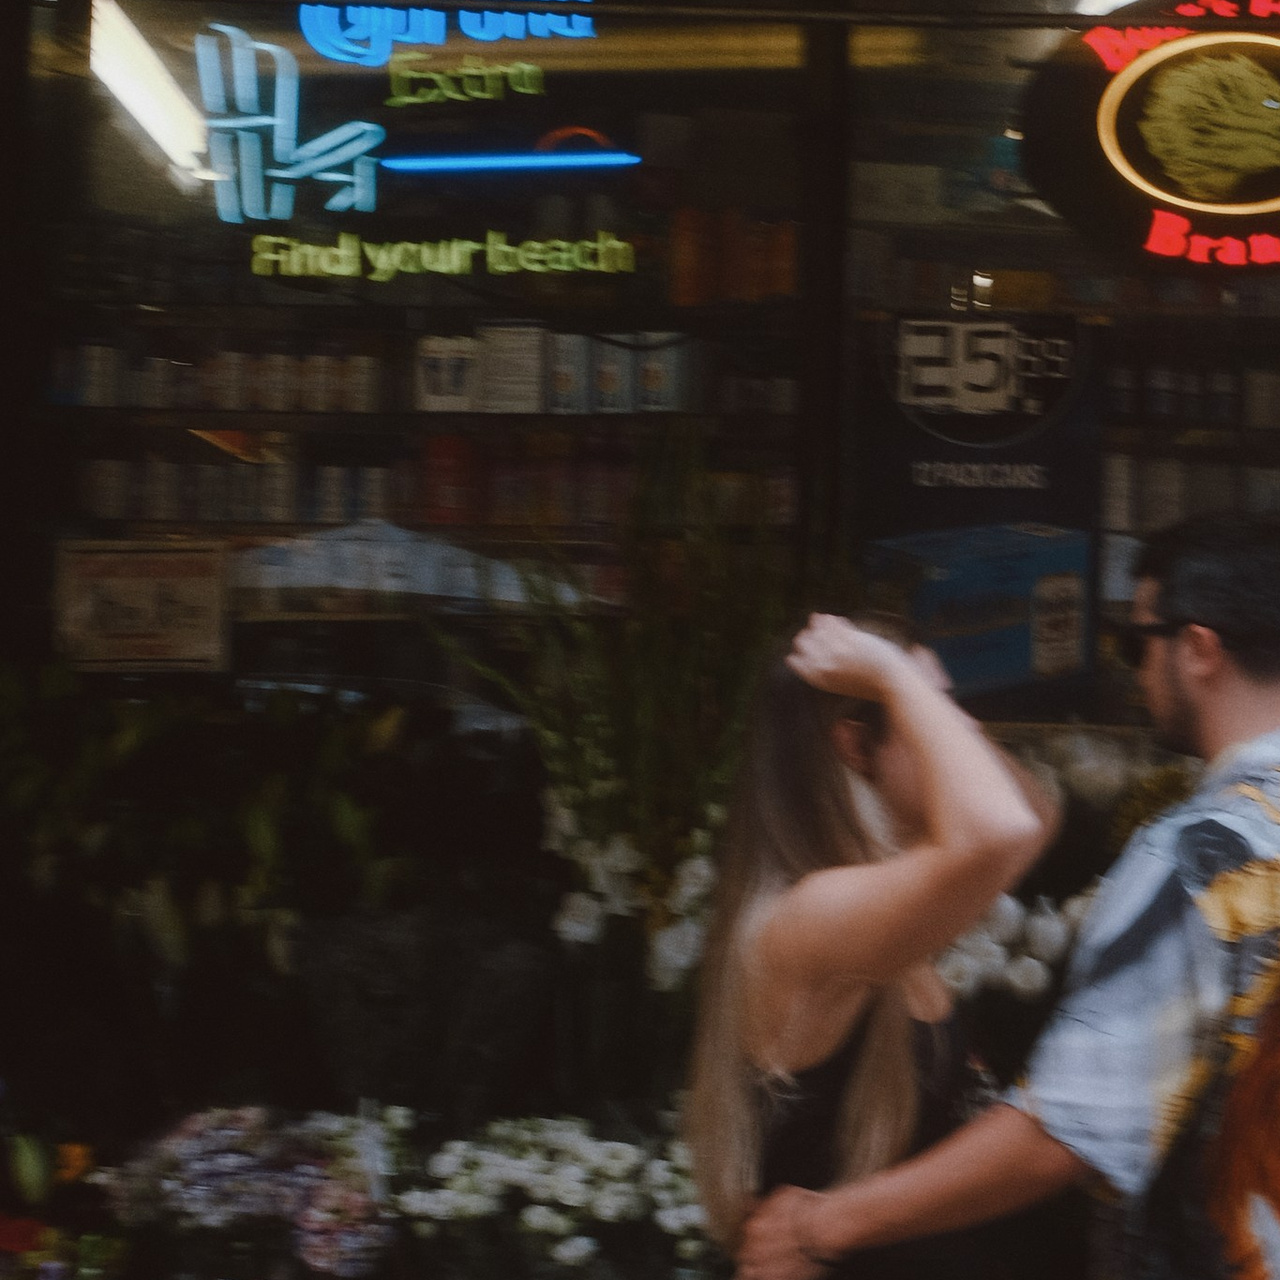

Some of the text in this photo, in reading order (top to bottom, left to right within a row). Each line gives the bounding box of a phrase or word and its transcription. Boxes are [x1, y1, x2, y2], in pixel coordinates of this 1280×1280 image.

[250, 228, 637, 283] Find your beach
